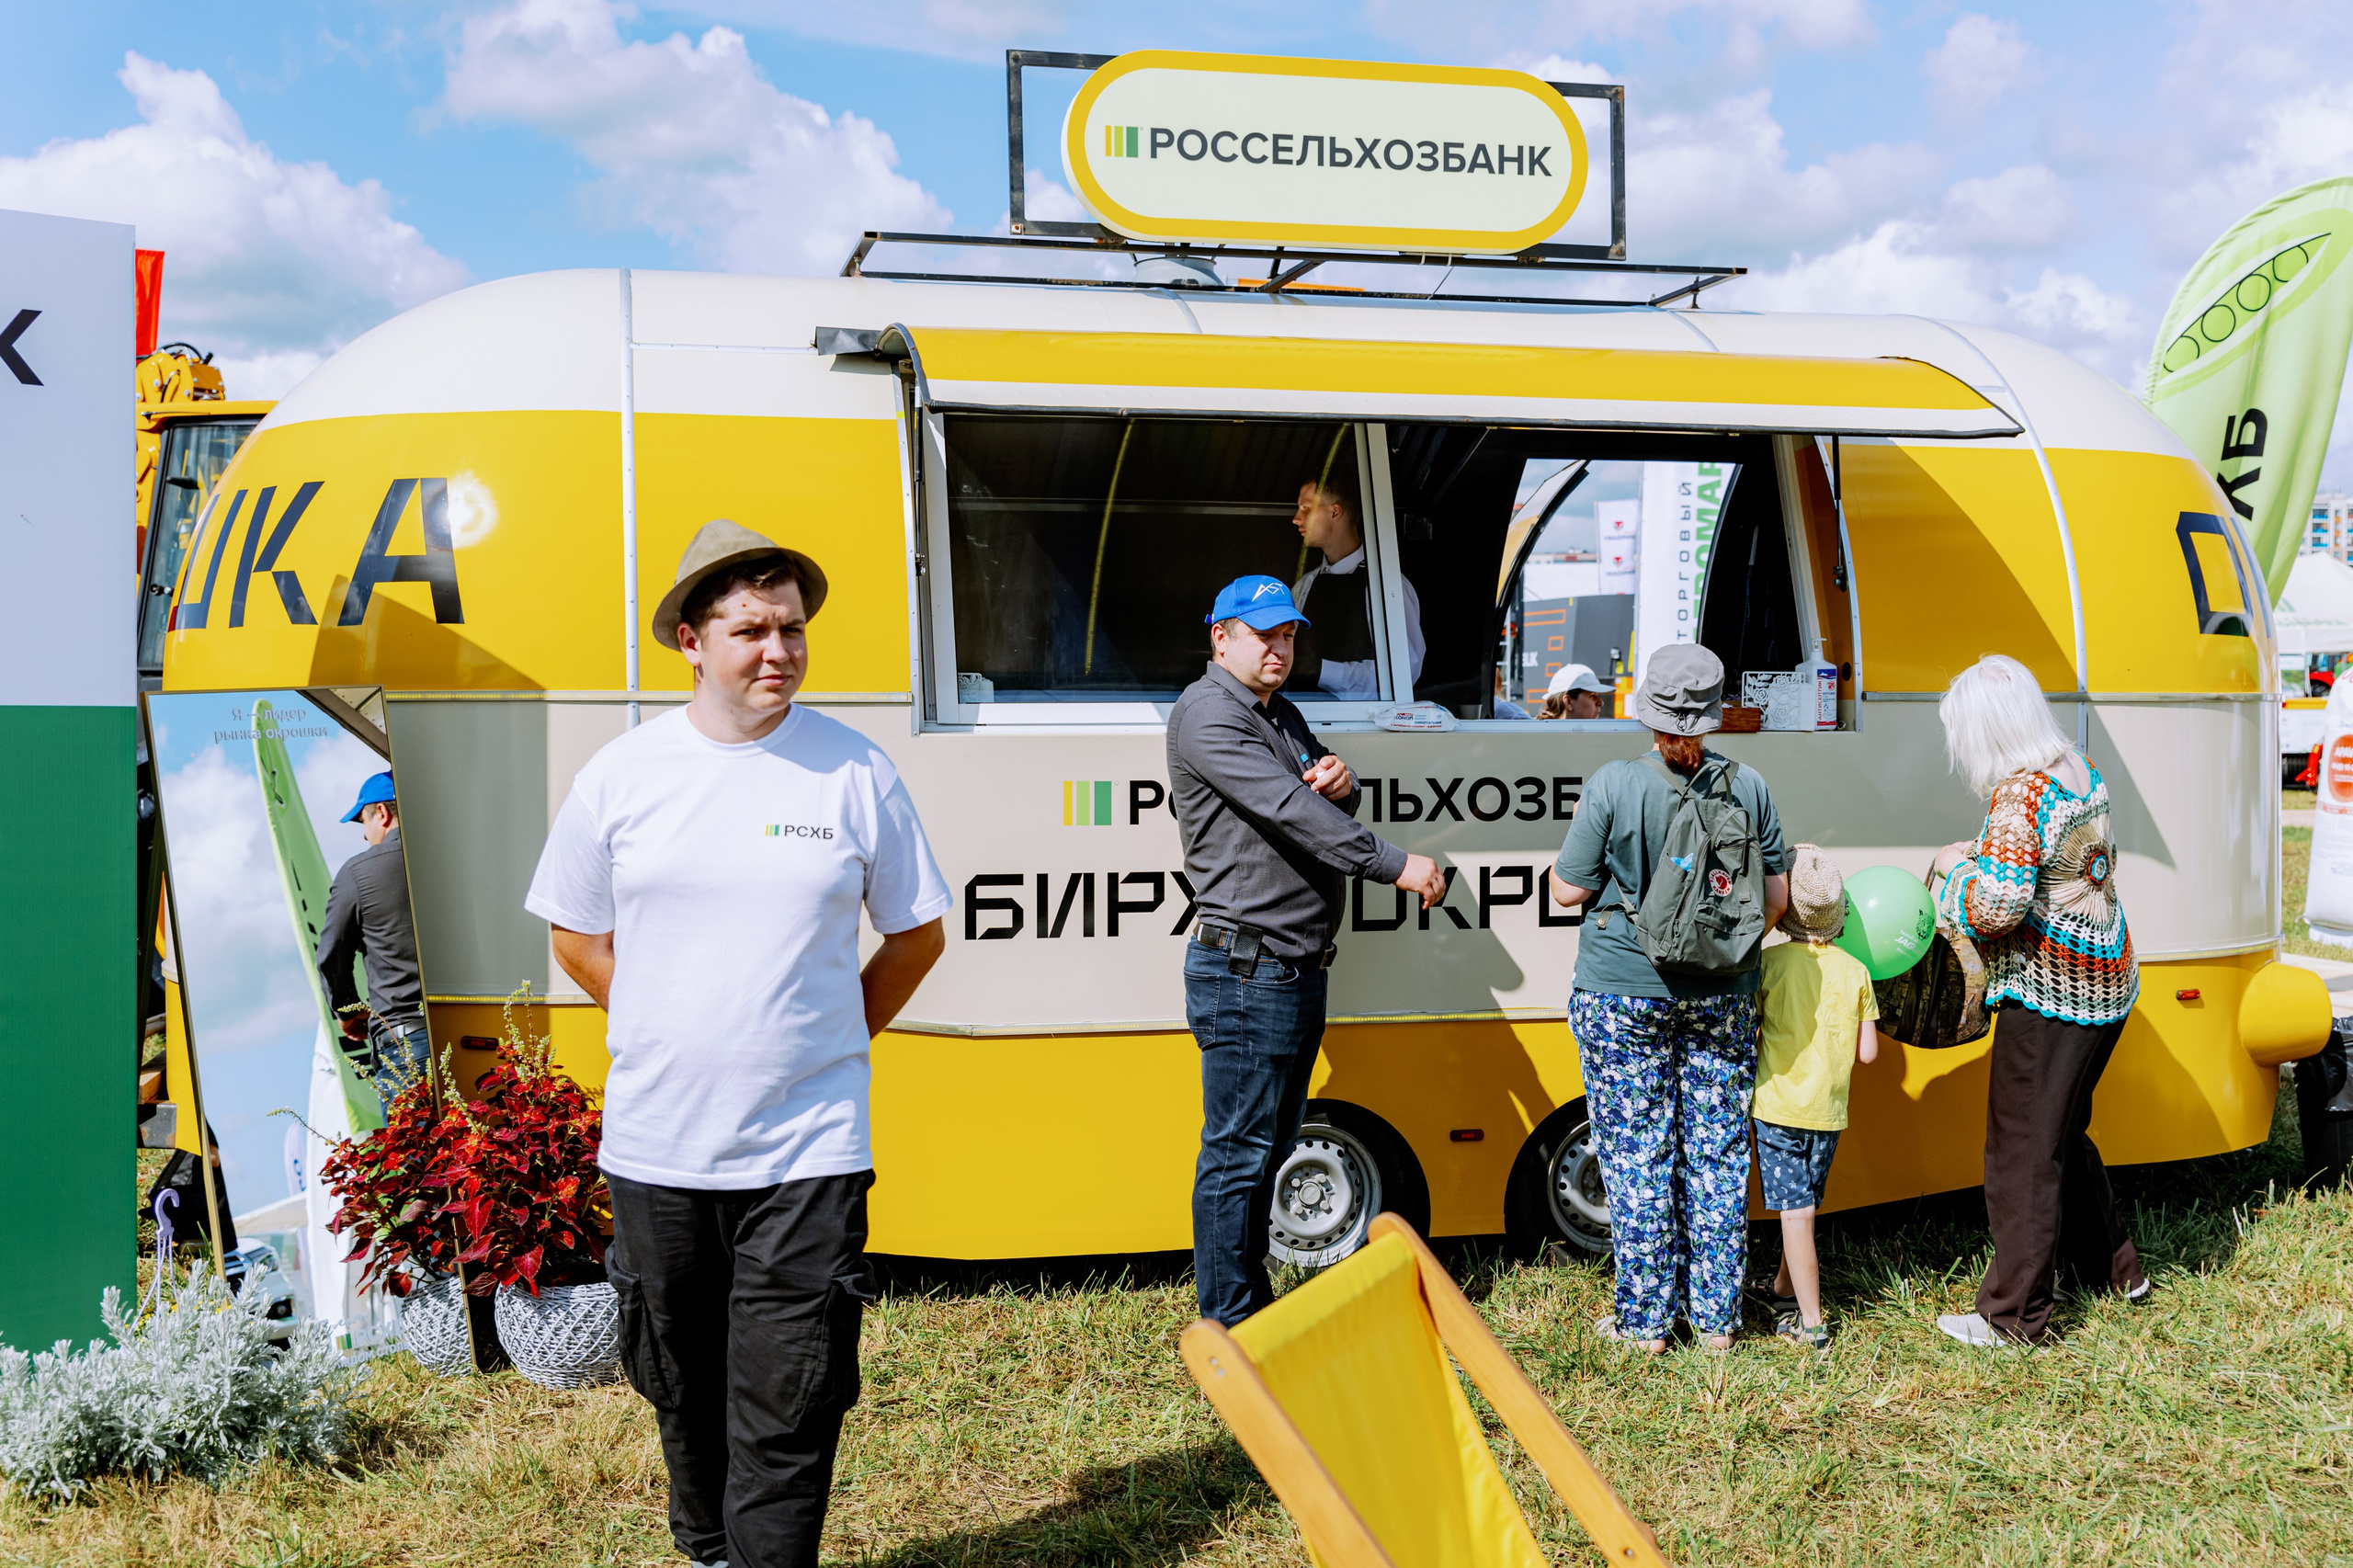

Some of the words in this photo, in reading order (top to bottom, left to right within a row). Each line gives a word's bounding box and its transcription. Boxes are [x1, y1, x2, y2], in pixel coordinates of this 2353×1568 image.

[1150, 127, 1553, 177] РОССЕЛЬХОЗБАНК
[1677, 483, 1692, 641] ТОРГОВЫЙ
[232, 708, 243, 721] Я
[263, 708, 307, 722] лидер
[214, 729, 262, 744] рынка
[265, 726, 329, 741] окрошки
[784, 824, 834, 840] РСХБ
